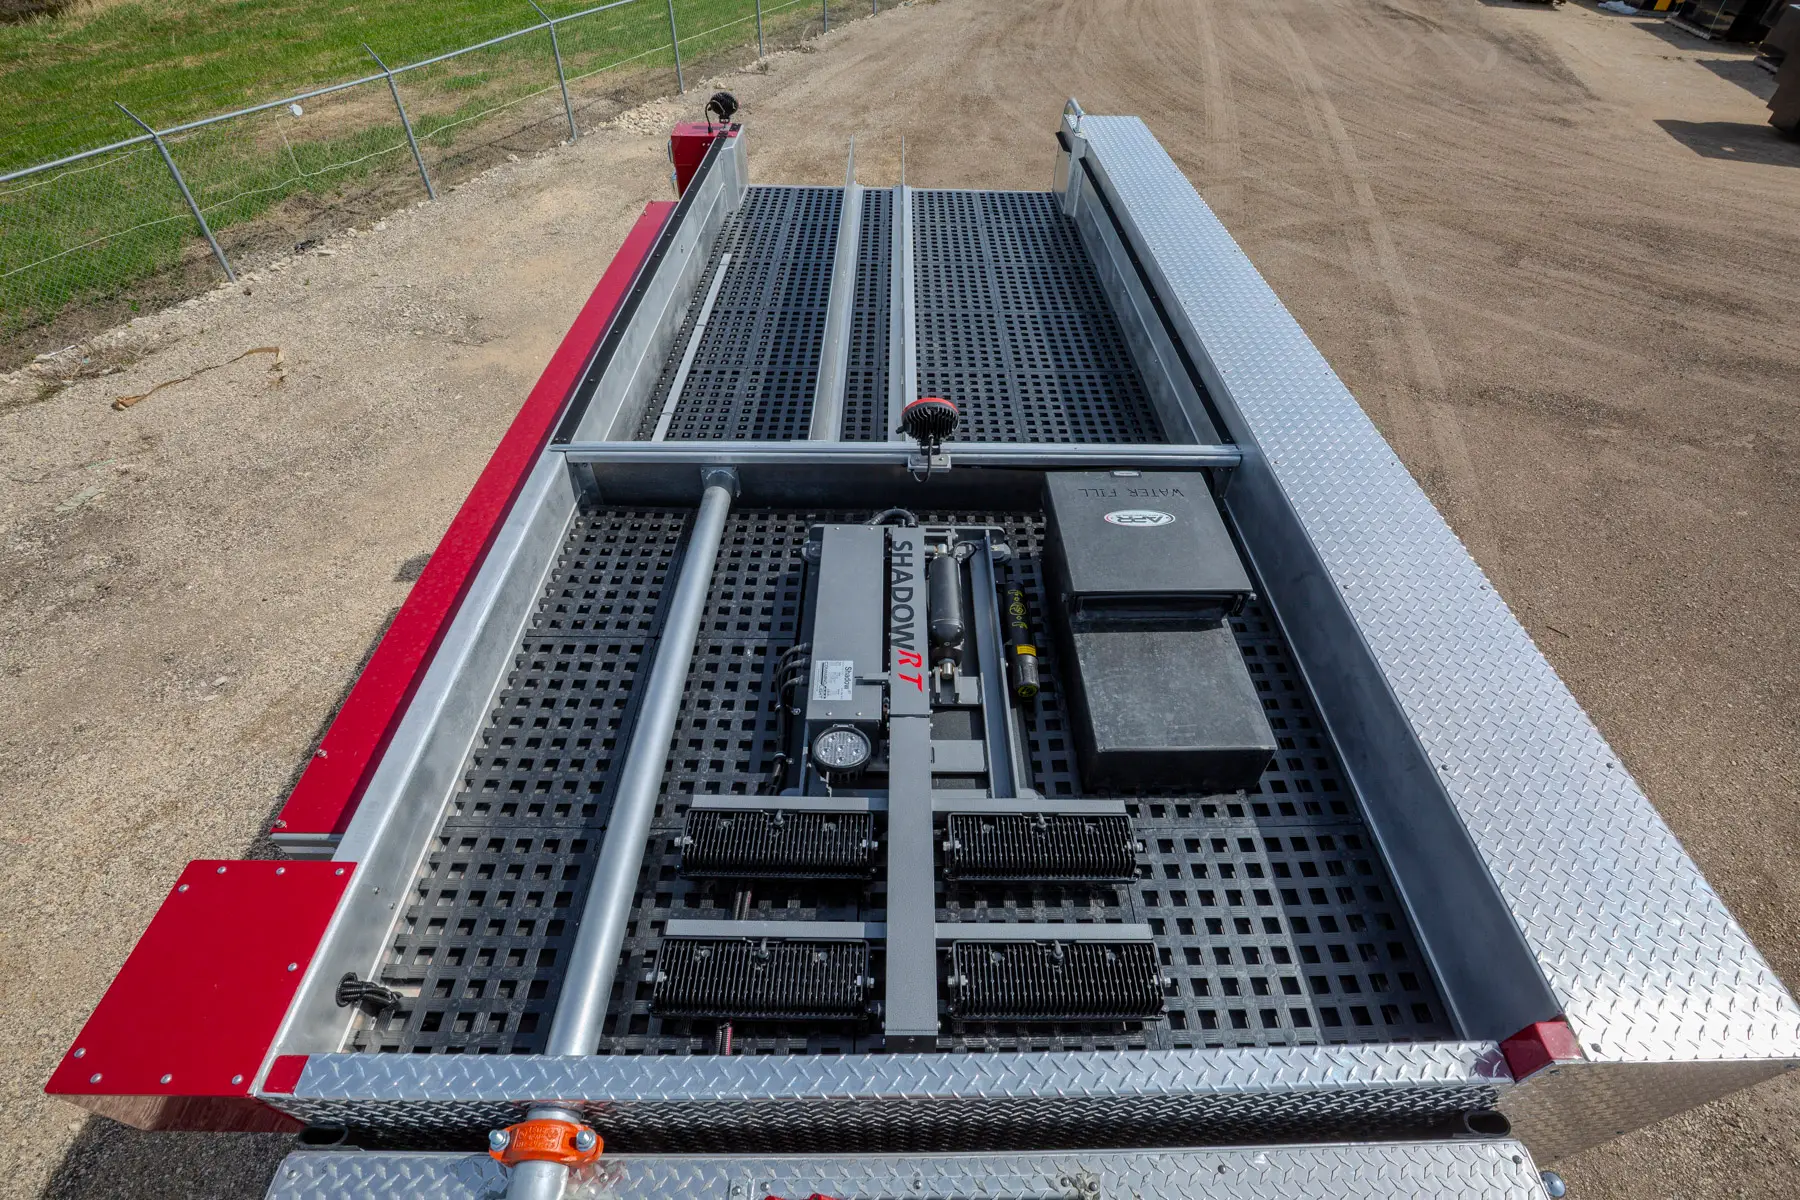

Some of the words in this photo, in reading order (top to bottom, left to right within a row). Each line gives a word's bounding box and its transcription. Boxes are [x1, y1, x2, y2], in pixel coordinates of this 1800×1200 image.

[1077, 489, 1117, 497] FILL
[1128, 489, 1184, 498] WATER
[890, 540, 915, 651] SHADOW
[844, 666, 852, 690] Shadow
[897, 649, 923, 693] RT
